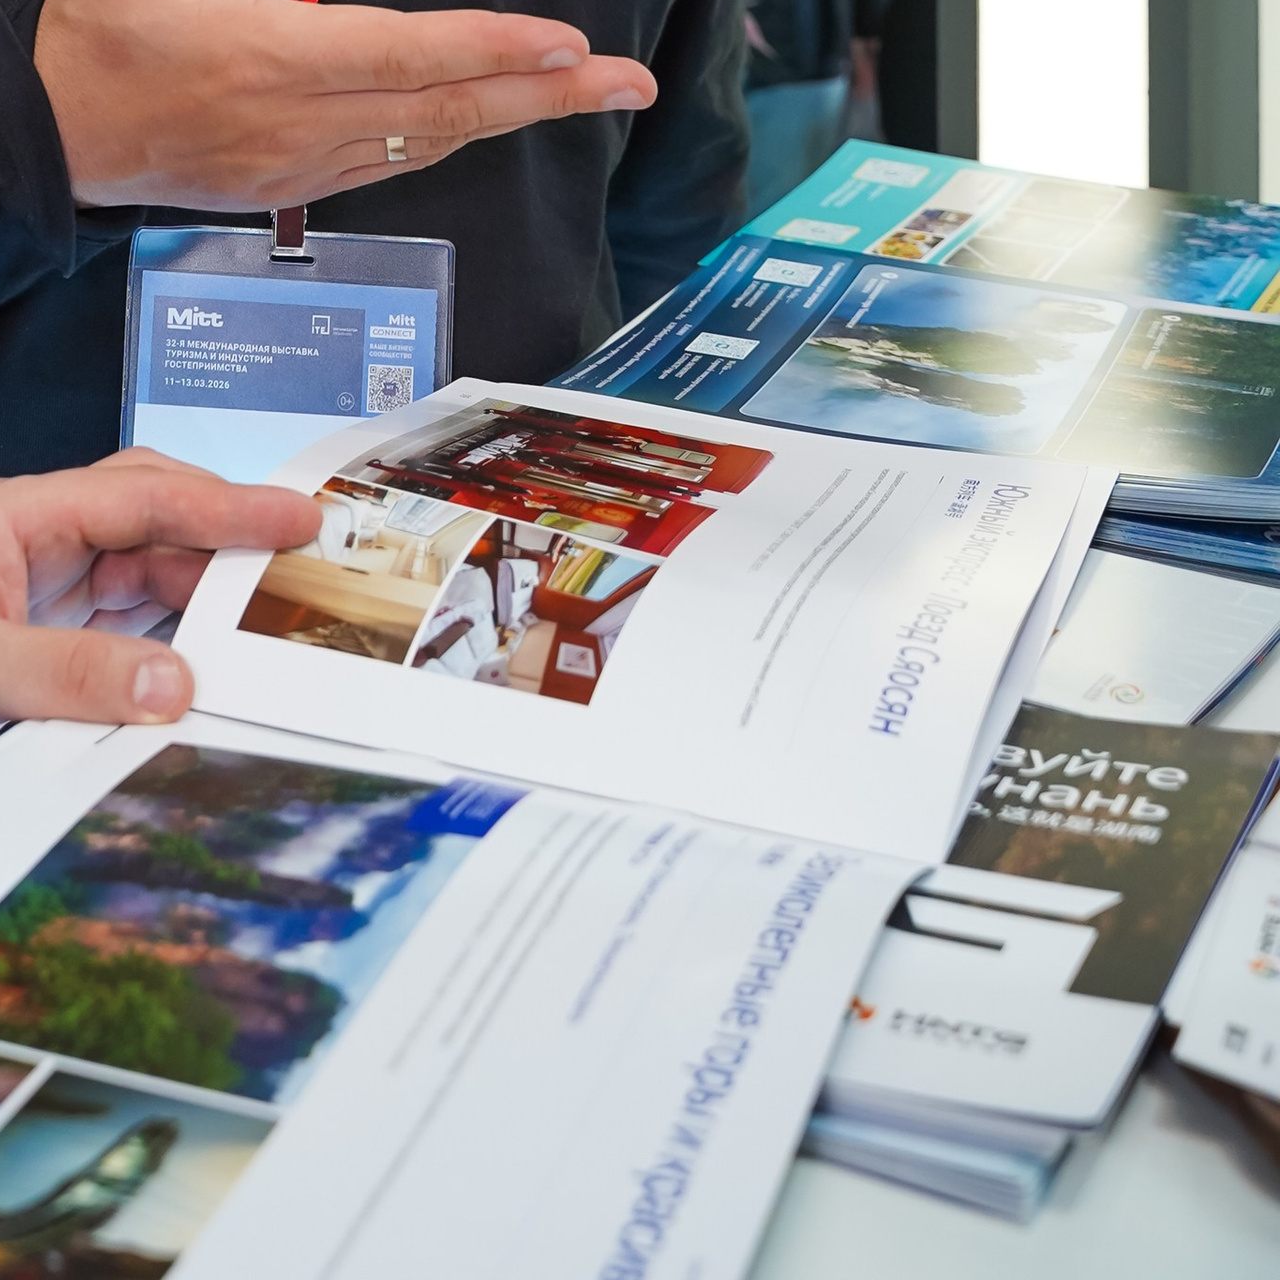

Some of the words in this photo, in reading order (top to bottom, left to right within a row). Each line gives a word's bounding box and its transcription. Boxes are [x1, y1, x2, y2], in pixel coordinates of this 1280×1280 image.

[167, 306, 224, 329] Mitt
[389, 314, 415, 326] Mitt
[372, 328, 412, 338] CONNECT
[165, 339, 185, 348] 32-Я
[187, 340, 270, 354] МЕЖДУНАРОДНАЯ
[271, 345, 319, 356] ВЫСТАВКА
[368, 351, 412, 359] СООБЩЕСТВО
[165, 349, 208, 360] ТУРИЗМА
[210, 352, 217, 360] И
[219, 353, 273, 364] ИНДУСТРИИ
[165, 360, 248, 373] ГОСТЕПРИИМСТВА
[974, 483, 1032, 537] Южный
[896, 591, 968, 645] Поезд
[869, 645, 940, 737] Сяосян
[992, 744, 1189, 791] вуйте
